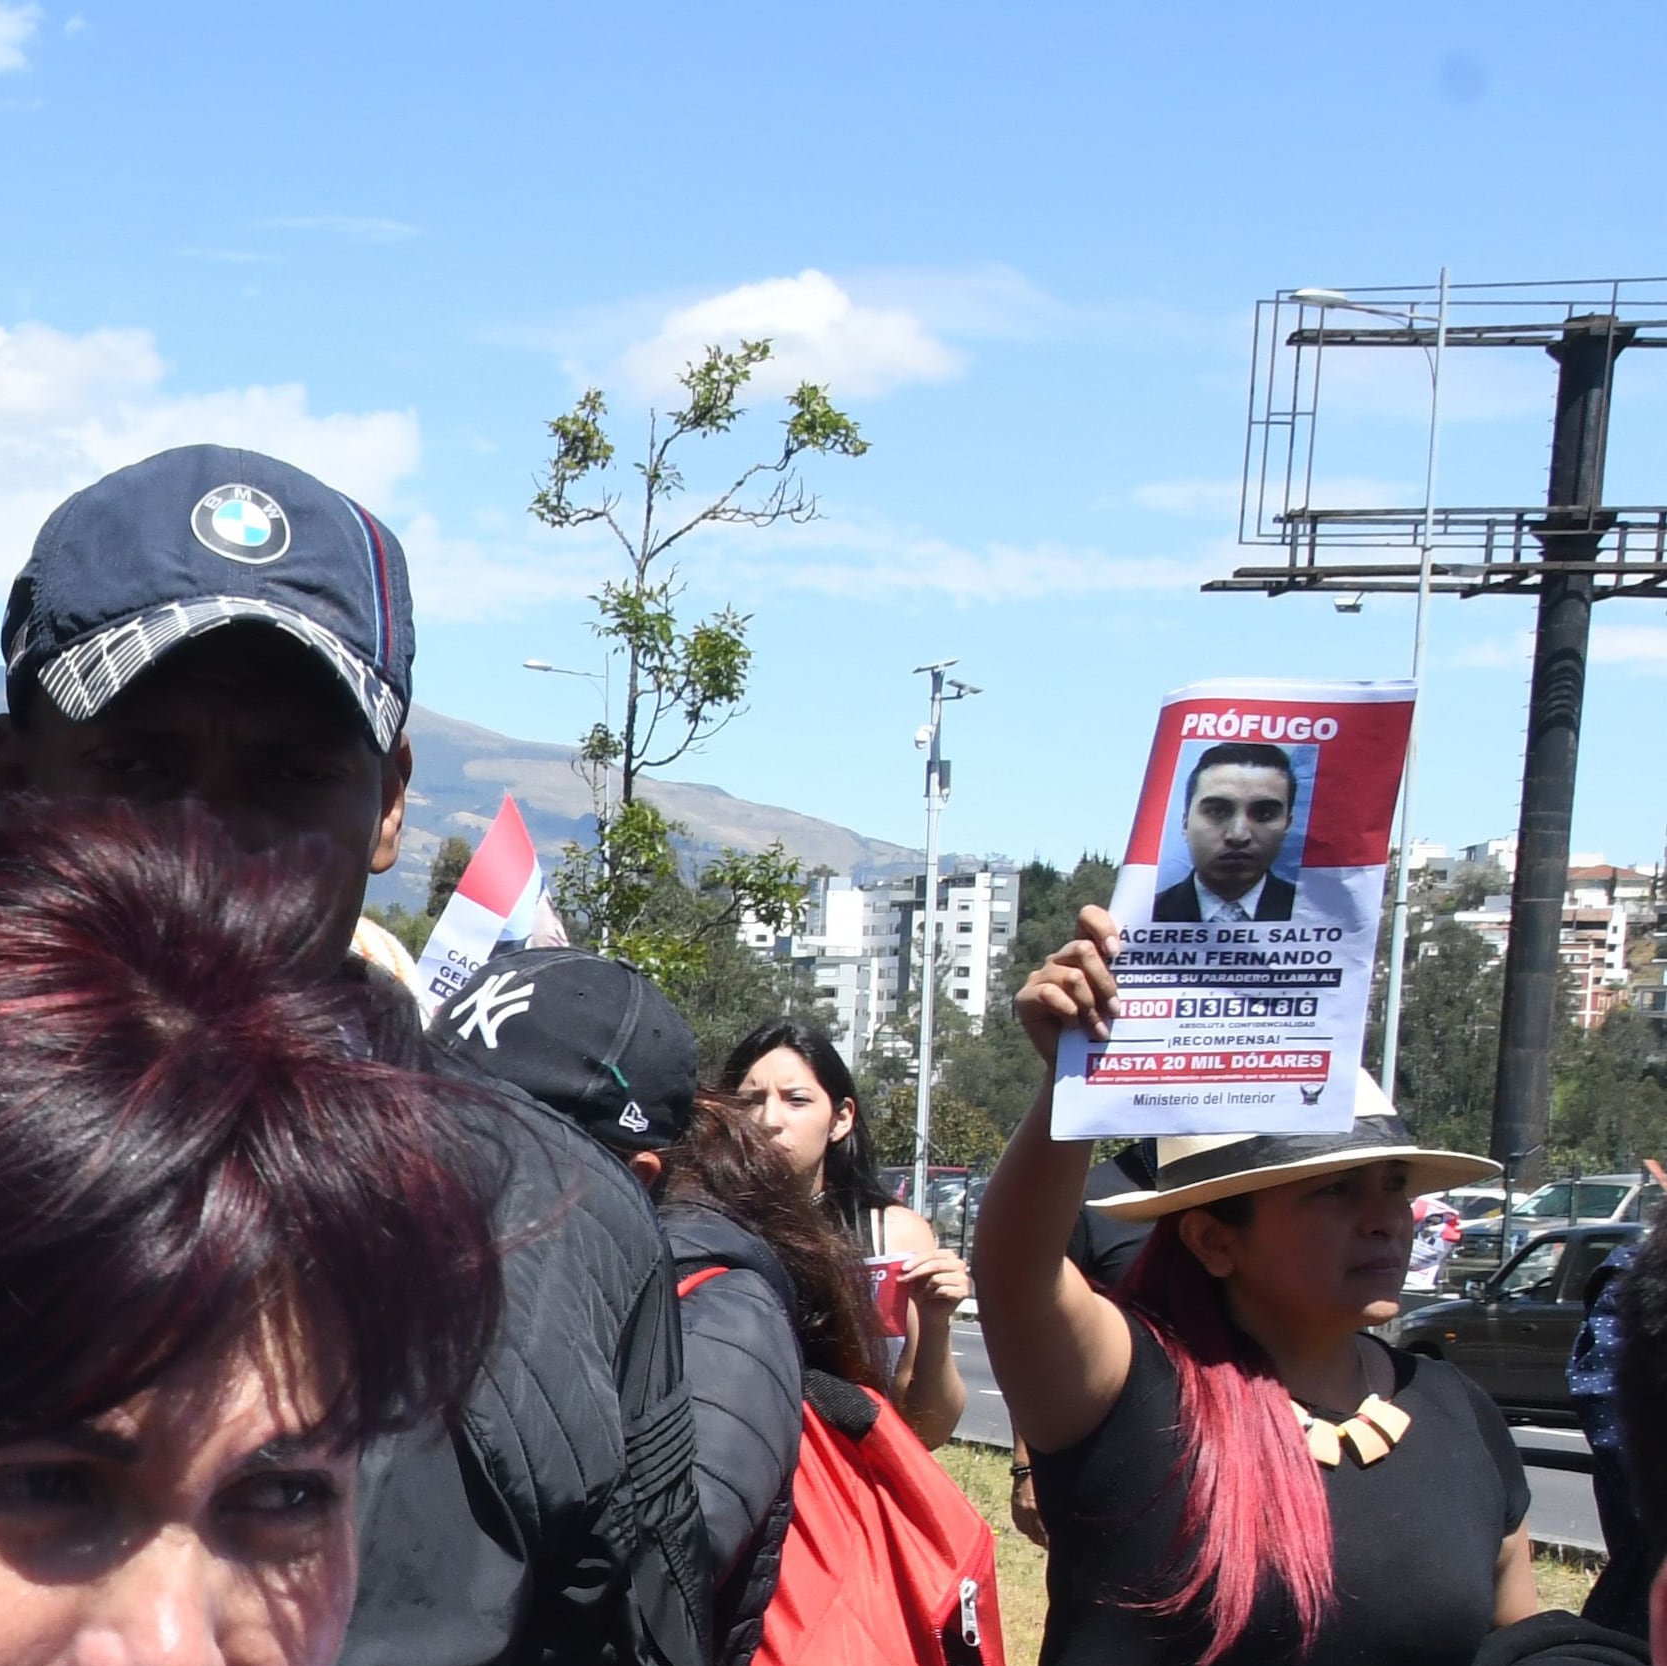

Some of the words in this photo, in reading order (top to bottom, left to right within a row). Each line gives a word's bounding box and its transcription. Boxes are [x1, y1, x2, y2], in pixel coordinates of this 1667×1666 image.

[203, 487, 281, 520] BMW
[1180, 708, 1339, 741] PRÓFUGO
[1216, 928, 1259, 944] DEL
[1268, 926, 1343, 944] SALTO
[1205, 949, 1333, 967] FERNANDO
[1116, 974, 1178, 984] CONOCES
[1181, 974, 1198, 983] SU
[1202, 973, 1270, 983] PARADERO
[1273, 973, 1317, 983] LLAMA
[1319, 973, 1337, 983] AL
[1118, 1000, 1167, 1017] 1800
[1167, 1034, 1281, 1049] ¡RECOMPENSA!
[1092, 1056, 1158, 1072] HASTA
[1162, 1056, 1185, 1070] 20
[1191, 1055, 1226, 1069] MIL
[1231, 1051, 1324, 1069] DÓLARES
[1133, 1092, 1200, 1107] Ministerio
[1203, 1092, 1224, 1105] del
[1227, 1091, 1276, 1105] Interior
